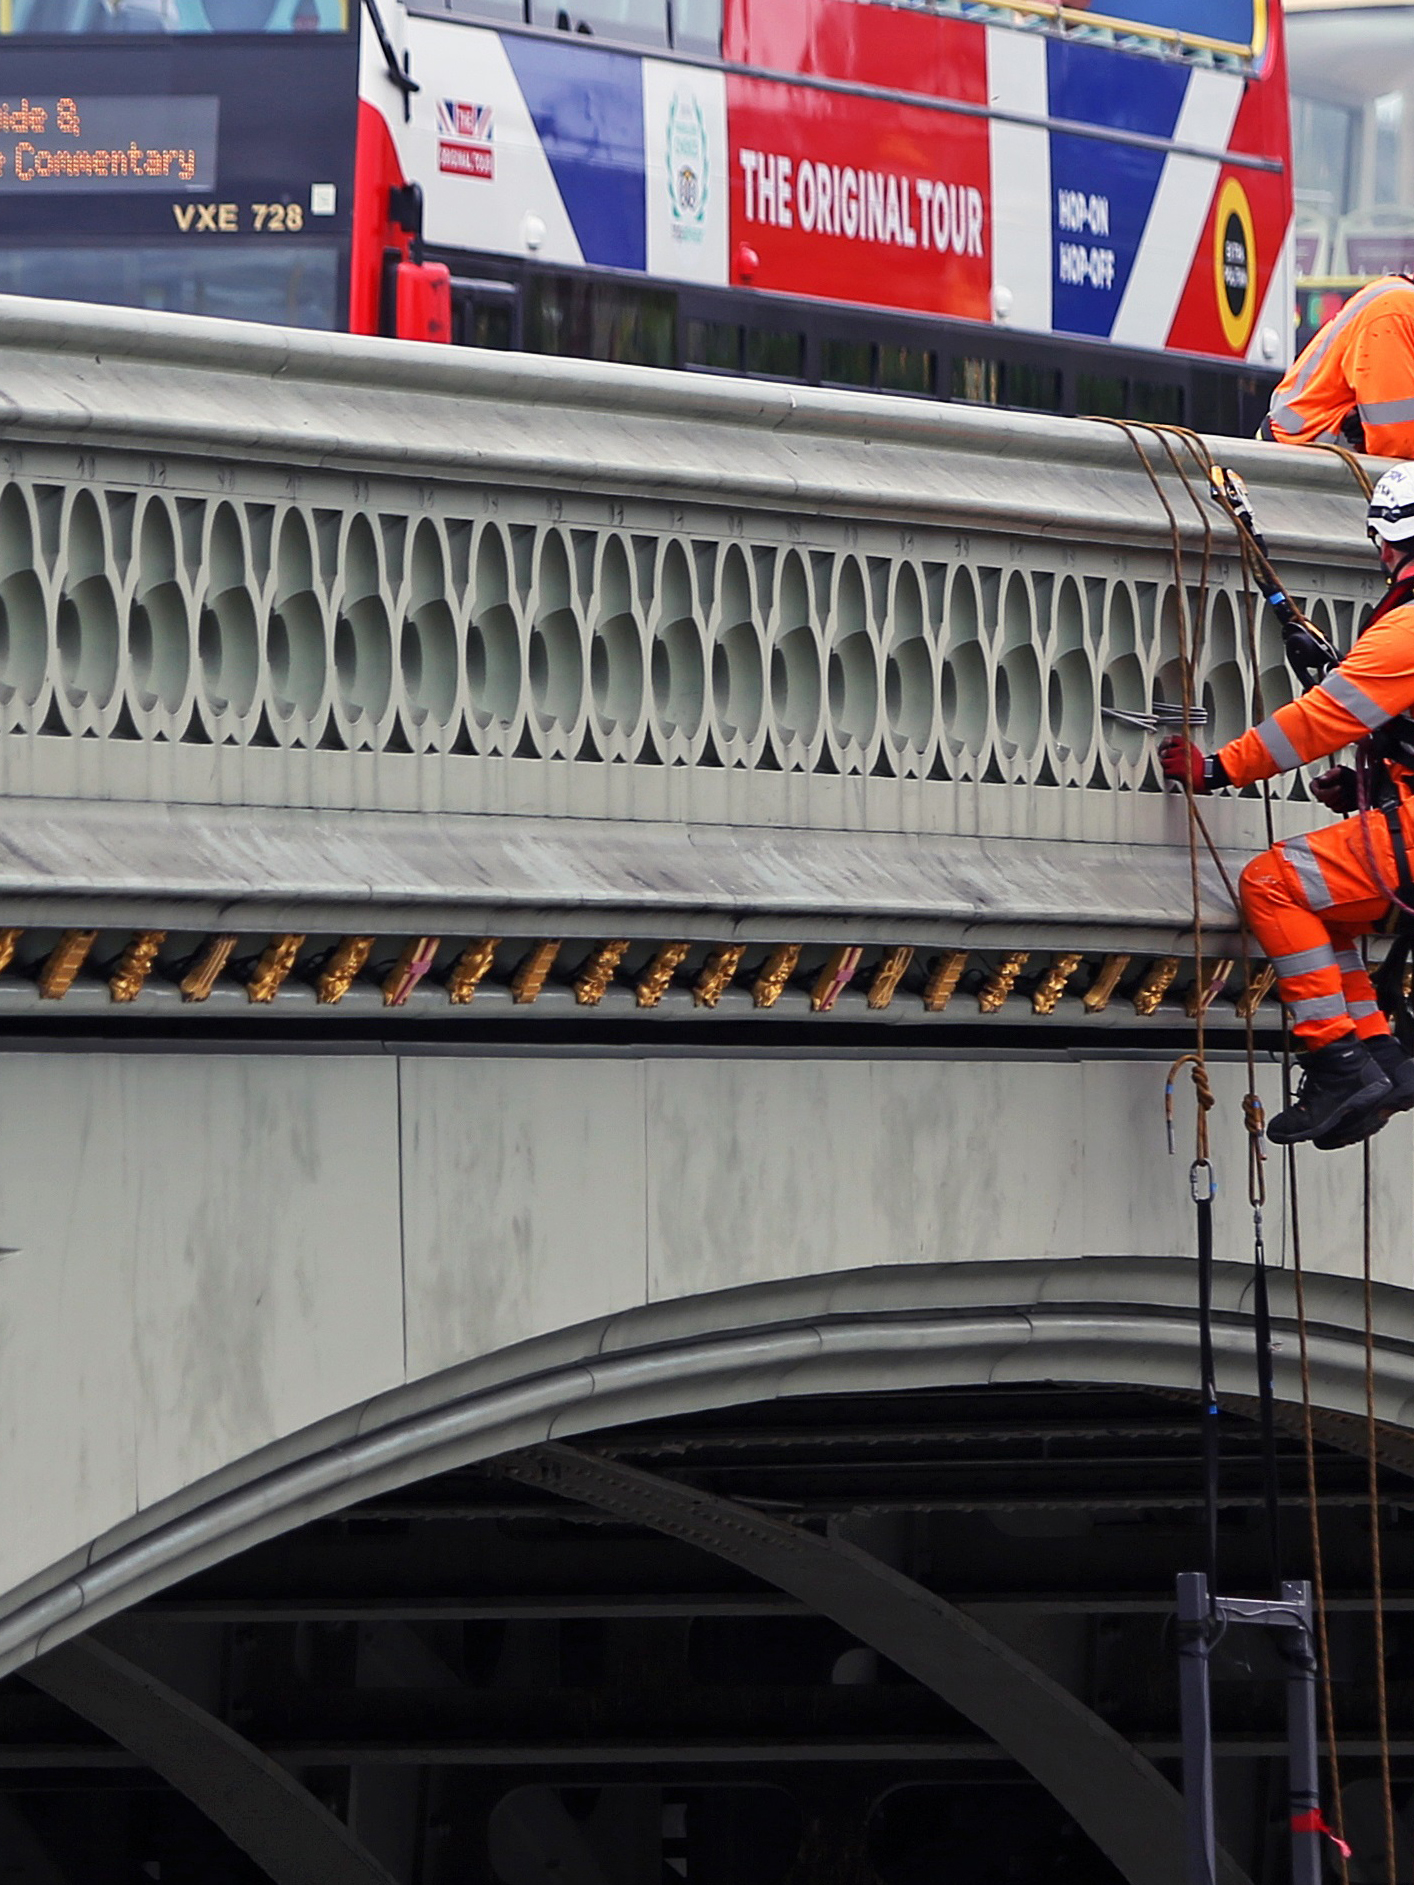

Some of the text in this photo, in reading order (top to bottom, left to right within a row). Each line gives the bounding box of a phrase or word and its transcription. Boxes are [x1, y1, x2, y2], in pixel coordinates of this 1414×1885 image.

[0, 97, 81, 137] ide &
[15, 141, 196, 181] Commentary
[172, 203, 304, 232] VXE 728
[739, 148, 984, 258] THE ORIGINAL TOUR
[1058, 187, 1110, 238] HOP-ON
[1059, 241, 1116, 291] HOP-OFF
